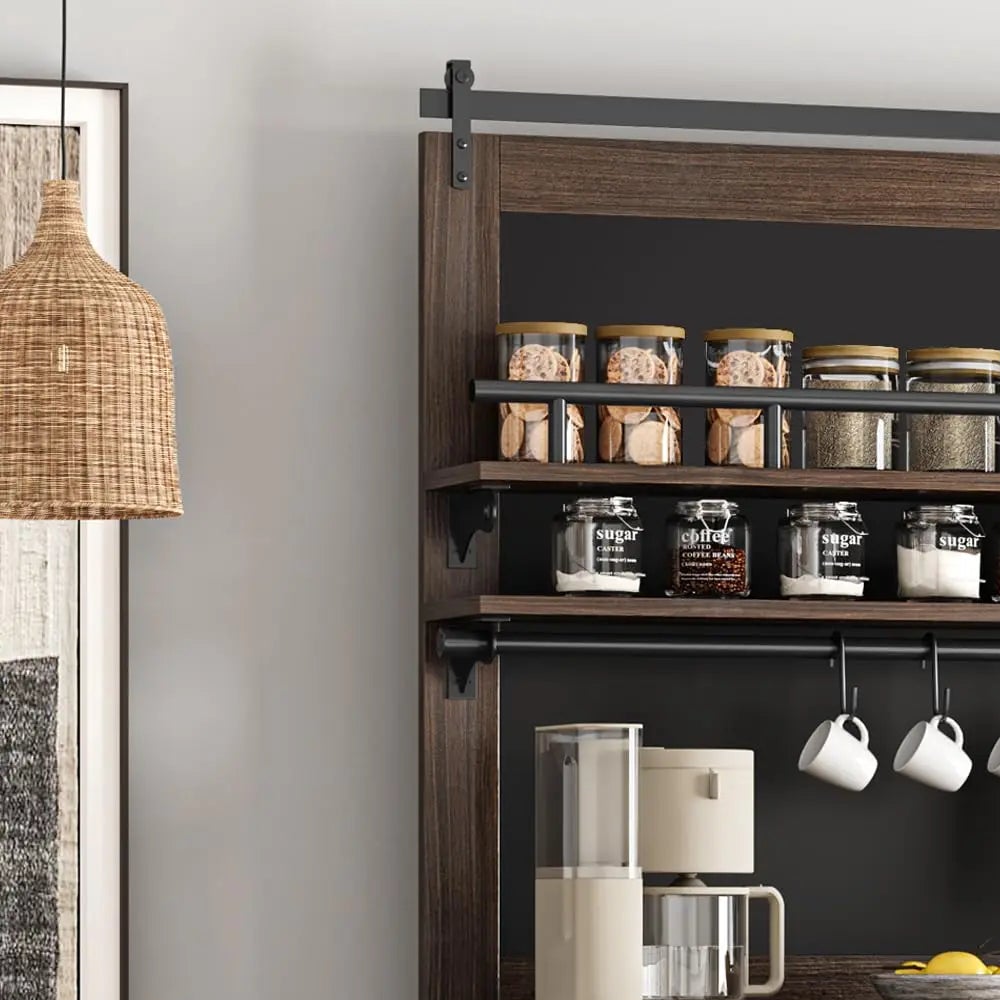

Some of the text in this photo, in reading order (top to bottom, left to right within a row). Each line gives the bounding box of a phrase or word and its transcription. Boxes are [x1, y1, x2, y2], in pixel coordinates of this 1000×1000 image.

[596, 529, 639, 544] sugar
[681, 528, 730, 543] coffee
[822, 533, 863, 548] sugar
[939, 536, 980, 551] sugar
